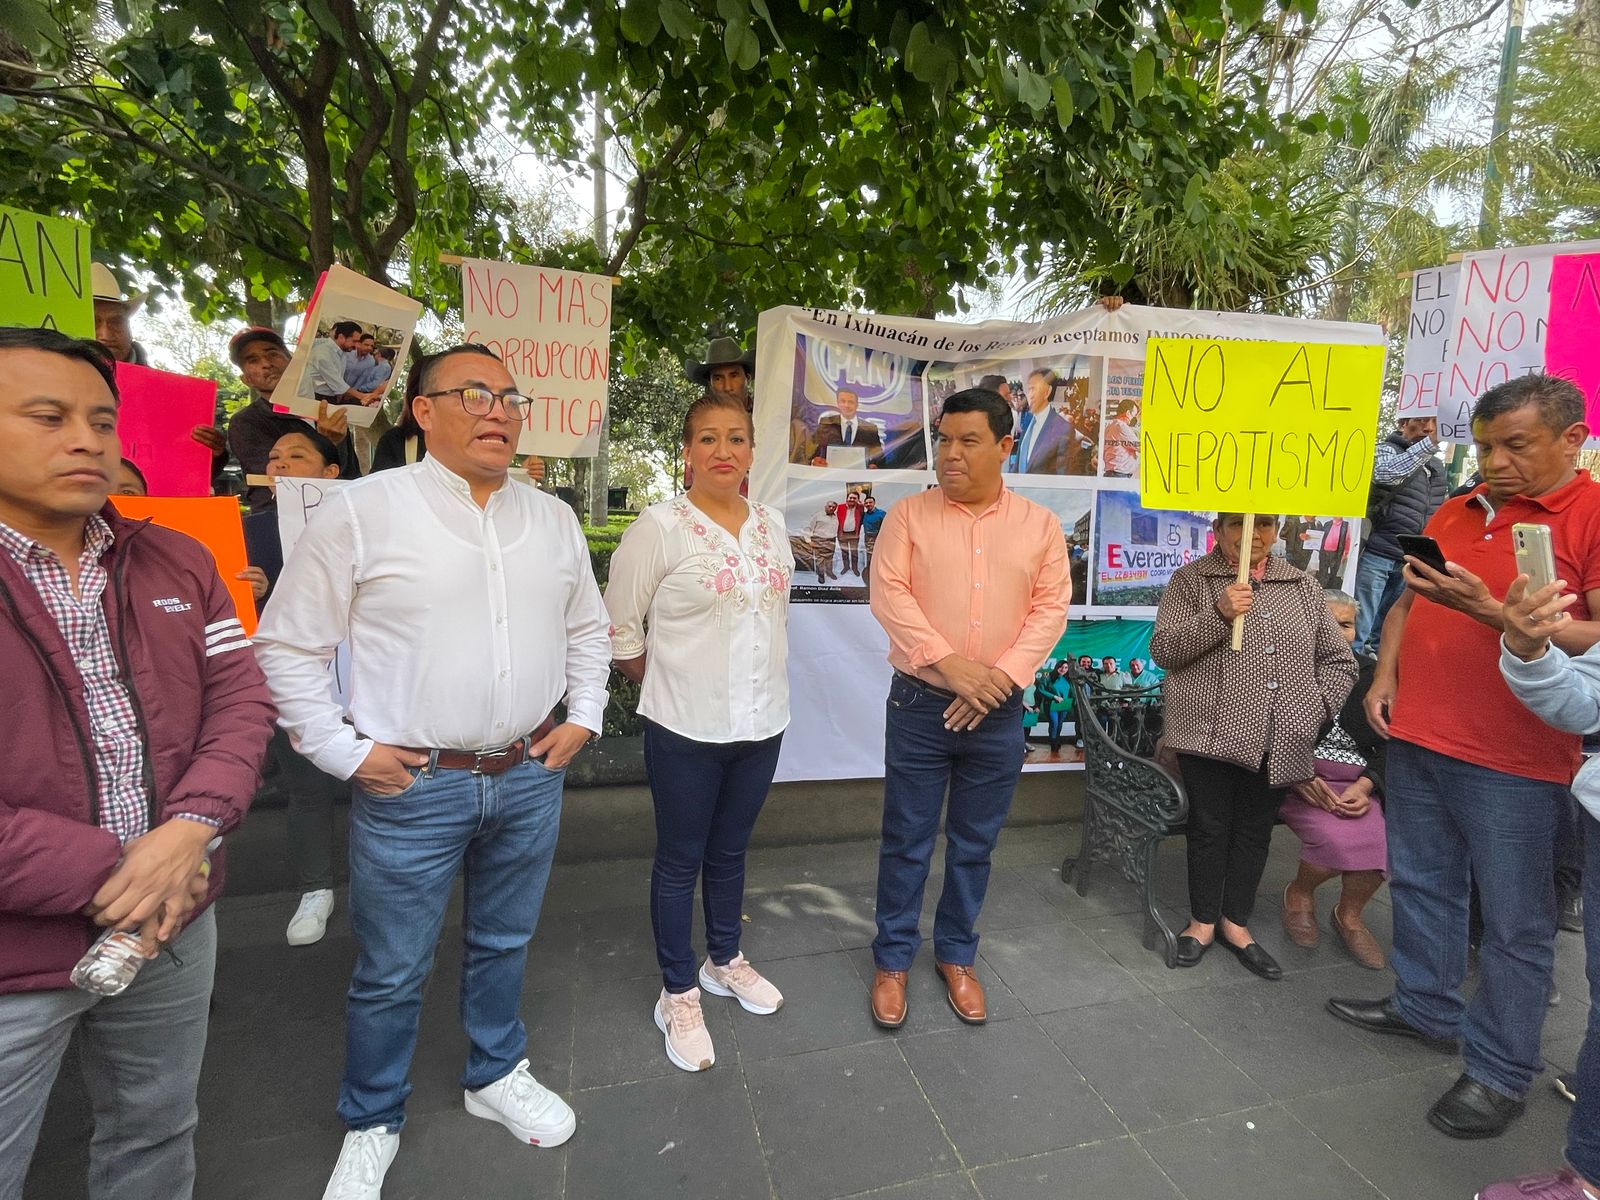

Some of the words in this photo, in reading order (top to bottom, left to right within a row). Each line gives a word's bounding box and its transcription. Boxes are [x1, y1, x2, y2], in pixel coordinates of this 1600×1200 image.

[468, 266, 519, 319] NO
[537, 273, 609, 328] MÁS
[1415, 271, 1450, 302] EL
[1465, 254, 1530, 305] NO
[844, 314, 929, 347] Ixhuacán
[933, 336, 955, 351] de
[956, 339, 981, 353] los
[1028, 334, 1047, 346] no
[1053, 327, 1140, 344] aceptamos
[1410, 308, 1445, 339] NO
[1456, 311, 1525, 356] NO
[1150, 344, 1226, 412] NO
[1269, 345, 1352, 411] AL
[1399, 372, 1443, 411] DE
[1440, 422, 1467, 439] DE
[1144, 428, 1367, 495] NEPOTISMO
[1107, 543, 1182, 569] Everardo
